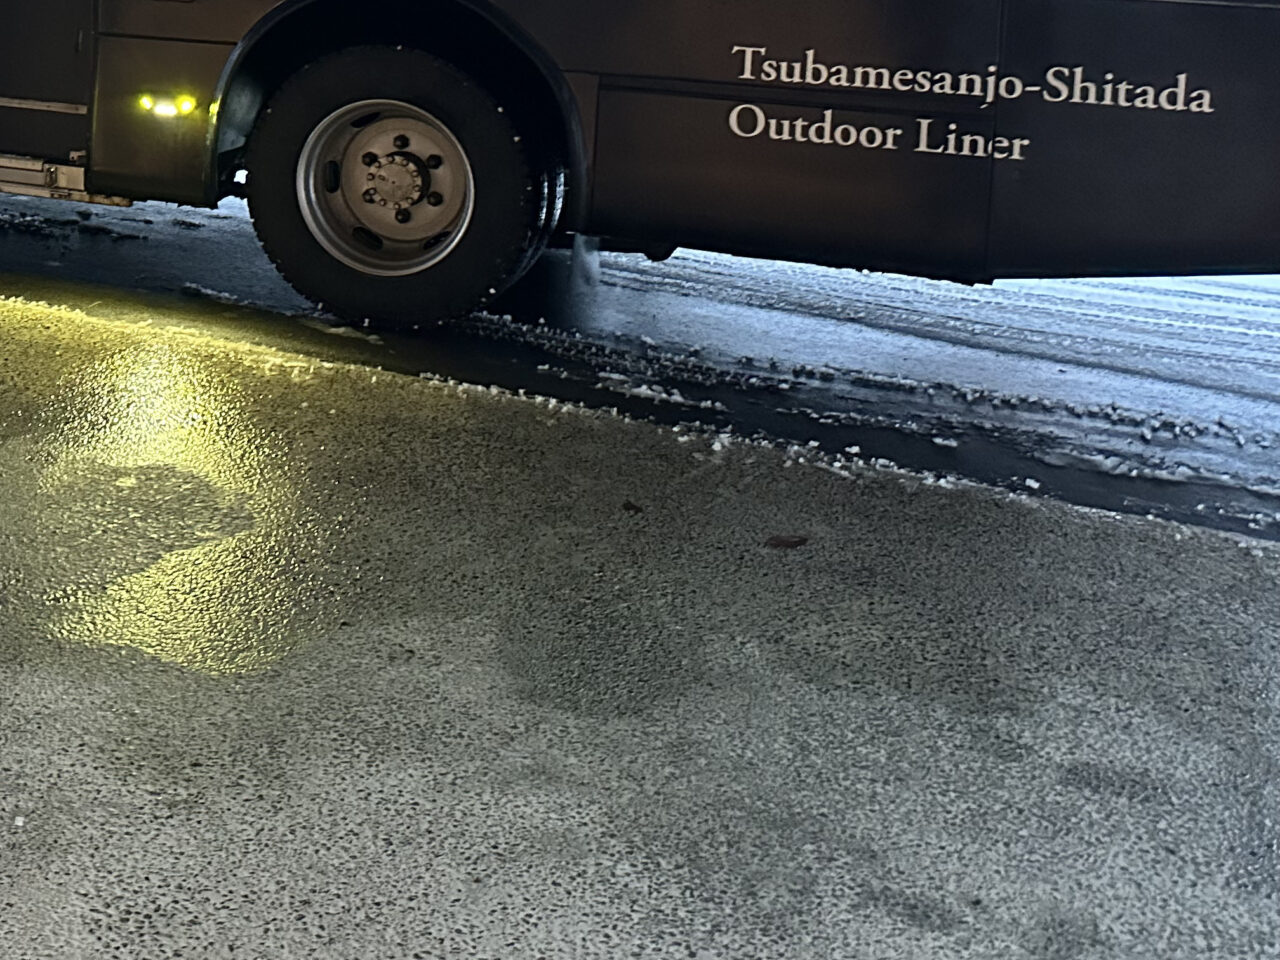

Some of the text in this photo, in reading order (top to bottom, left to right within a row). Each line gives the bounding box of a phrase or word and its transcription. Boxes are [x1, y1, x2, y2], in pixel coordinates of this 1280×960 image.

[731, 45, 1216, 113] Tsubamesanjo-Shitada
[728, 103, 1031, 161] Outdoor Liner
